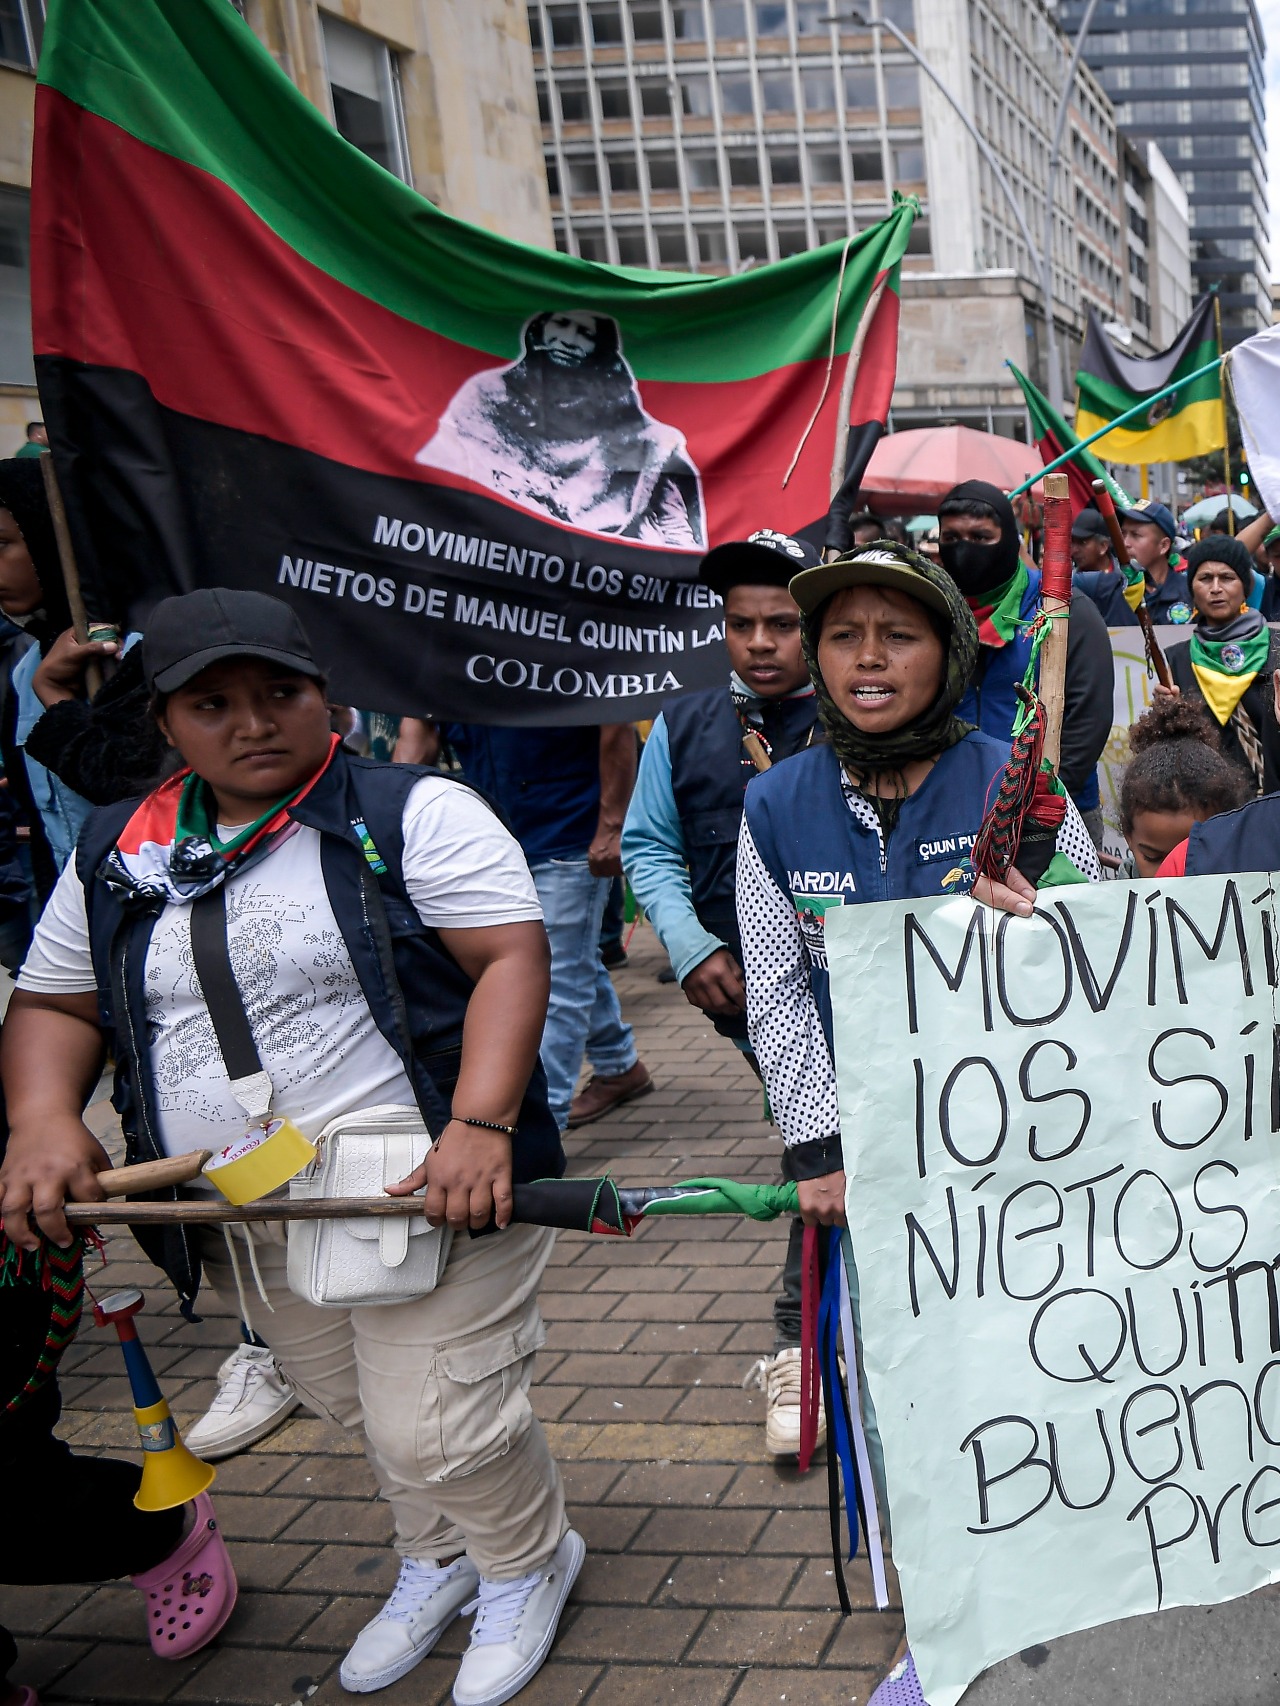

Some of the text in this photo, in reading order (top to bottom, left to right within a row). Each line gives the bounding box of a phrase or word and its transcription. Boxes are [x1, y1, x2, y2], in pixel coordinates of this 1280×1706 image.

[372, 515, 565, 583] MOVIMIENTO
[570, 560, 622, 597] LOS
[628, 573, 671, 603] SIN
[278, 554, 396, 608] NIETOS
[404, 584, 447, 619] DE
[454, 597, 573, 643] MANUEL
[579, 618, 685, 653] QUINTÍN
[465, 654, 685, 699] COLOMBIA
[919, 838, 956, 861] ÇUUN
[787, 870, 856, 893] ARDIA
